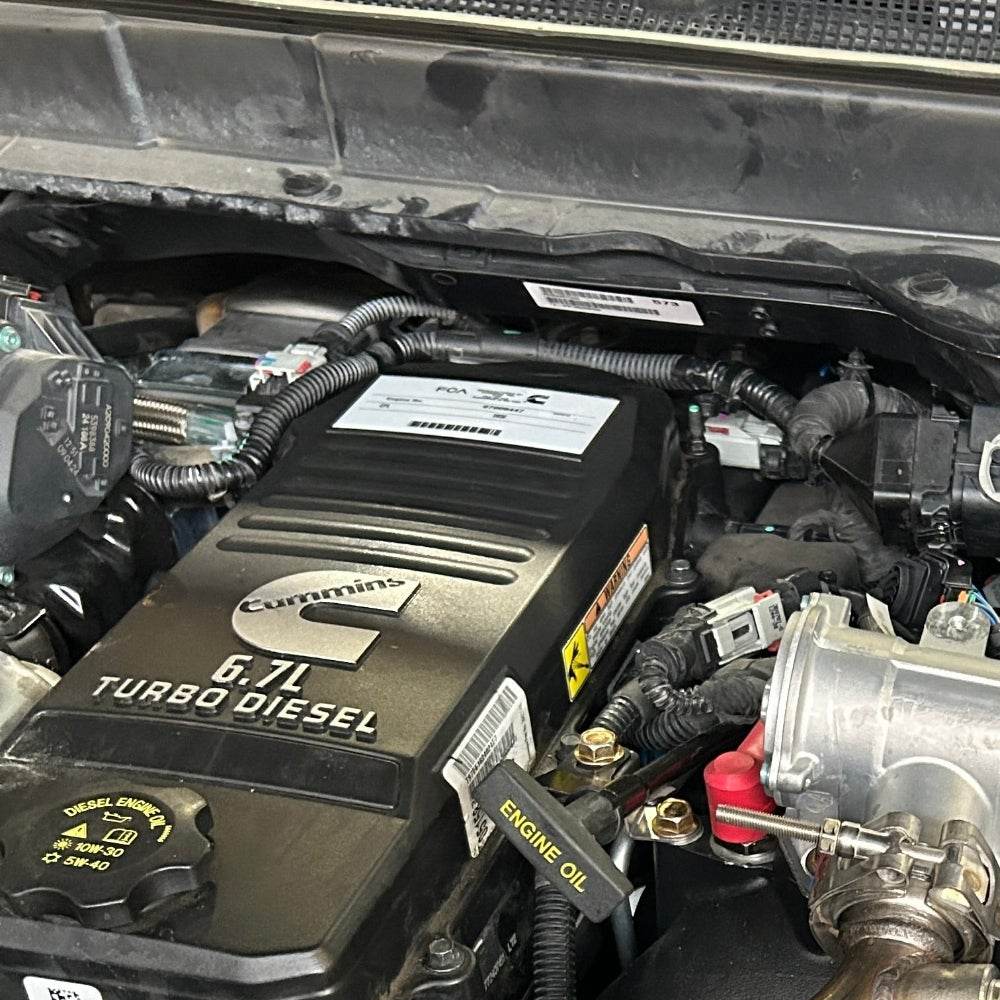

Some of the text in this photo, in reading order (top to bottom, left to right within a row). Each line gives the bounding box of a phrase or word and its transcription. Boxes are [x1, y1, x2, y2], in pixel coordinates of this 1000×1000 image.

[239, 576, 405, 613] Cummins
[211, 654, 311, 693] 6.7L
[92, 676, 378, 735] TURBO DIESEL
[63, 797, 167, 830] DIESEL ENGINE OIL
[63, 855, 111, 871] 5W-40
[75, 842, 125, 858] 10W-30
[499, 799, 589, 893] ENGINE OIL
